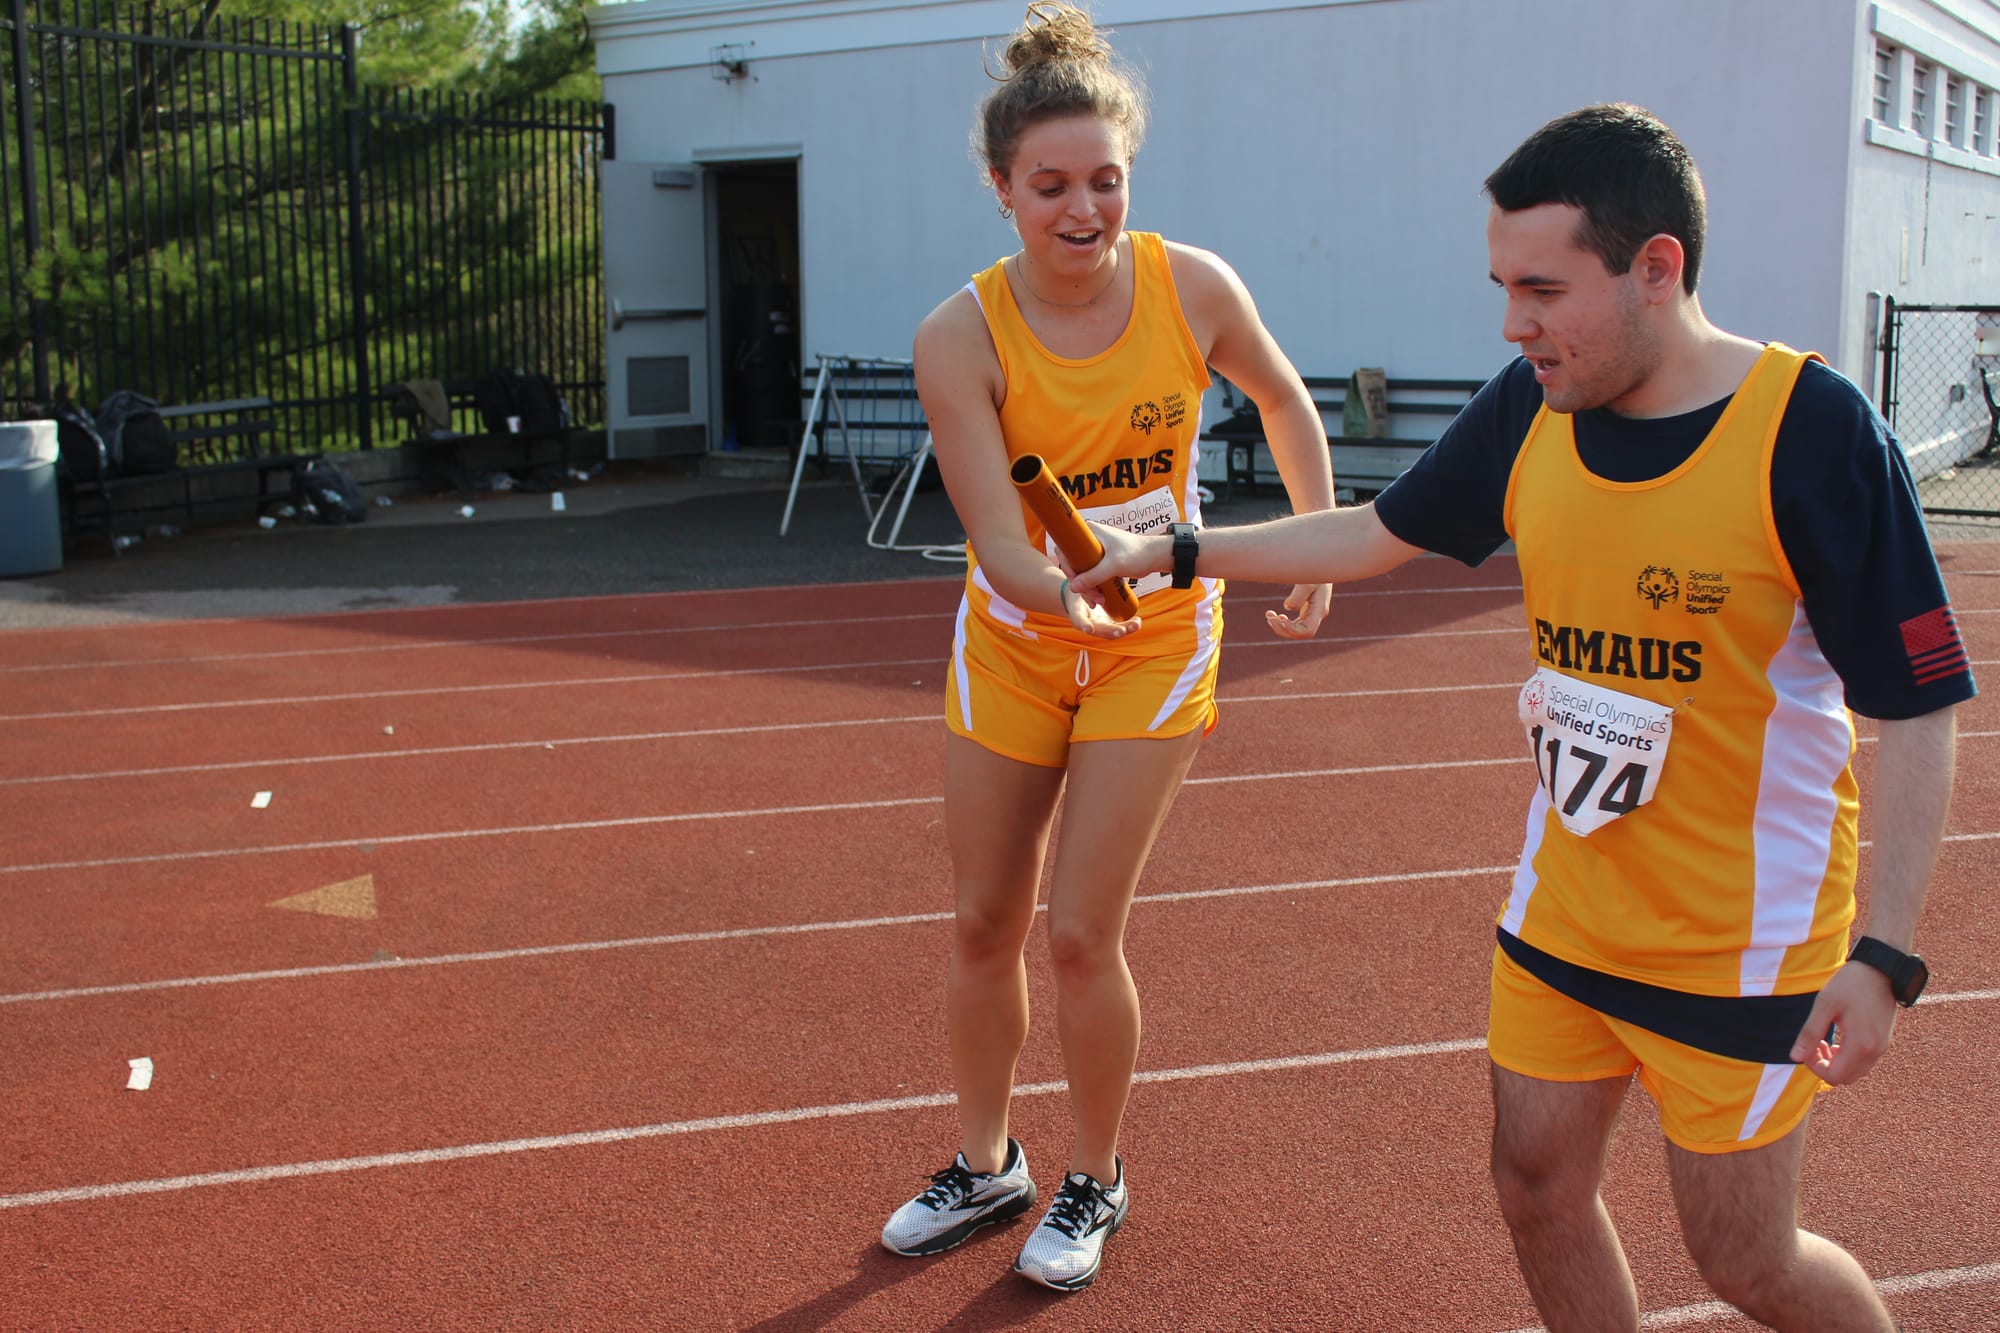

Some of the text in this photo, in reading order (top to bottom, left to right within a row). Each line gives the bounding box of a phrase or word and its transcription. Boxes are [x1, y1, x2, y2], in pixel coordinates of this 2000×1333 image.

[1165, 407, 1185, 420] Unified
[1166, 417, 1184, 429] Sports
[1058, 448, 1174, 501] MMAUS
[1127, 497, 1173, 521] Olympics
[1134, 512, 1171, 535] Sports
[1688, 569, 1722, 581] Special
[1686, 581, 1731, 594] Olympics
[1686, 593, 1725, 604] Unified
[1685, 604, 1719, 615] Sports
[1535, 617, 1703, 683] EMMAUS
[1549, 685, 1667, 734] Special Olympics
[1546, 705, 1653, 751] Unified Sports
[1531, 724, 1648, 817] 1174
